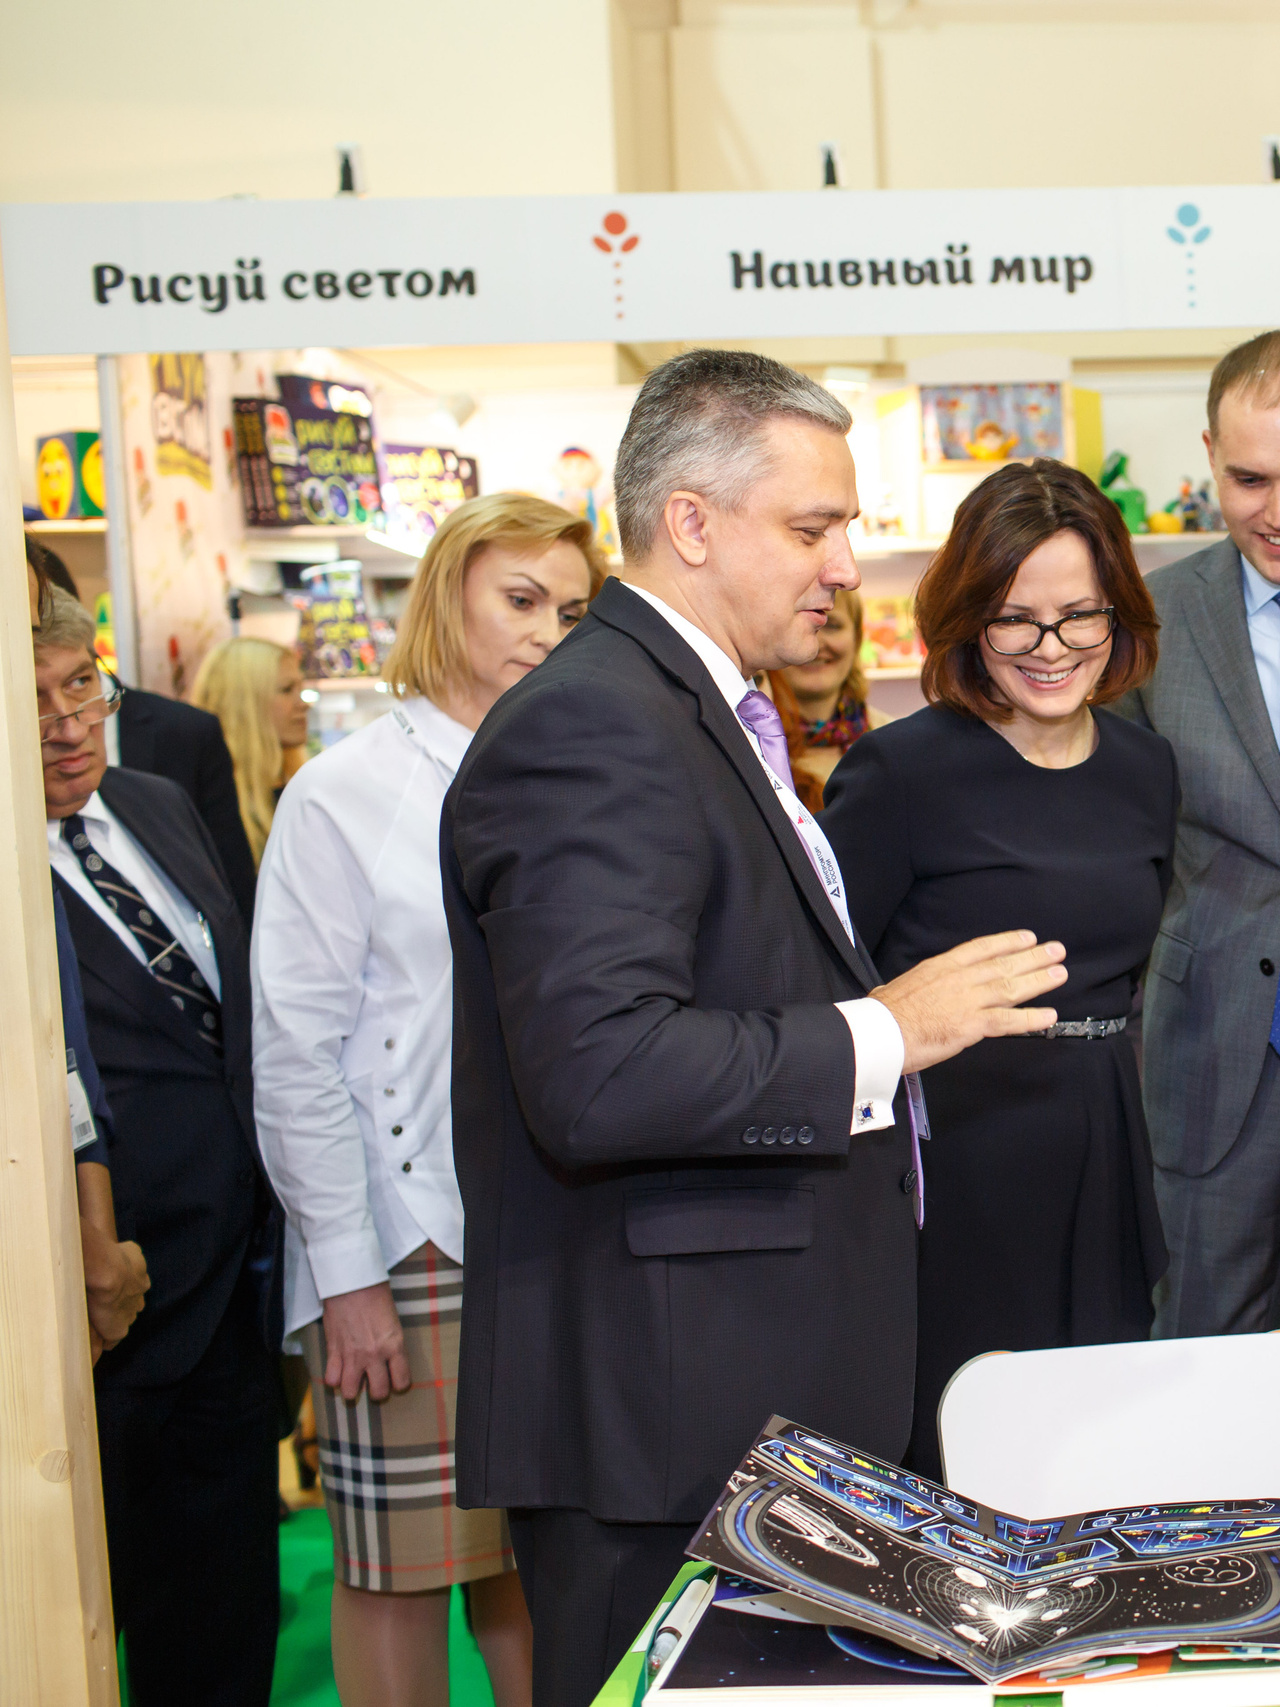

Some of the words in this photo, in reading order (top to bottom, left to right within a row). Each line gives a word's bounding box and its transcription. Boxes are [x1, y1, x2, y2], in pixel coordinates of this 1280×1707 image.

[92, 257, 267, 314] Рисуй
[282, 267, 477, 300] светом
[731, 243, 974, 290] Наивный
[989, 256, 1093, 294] мир
